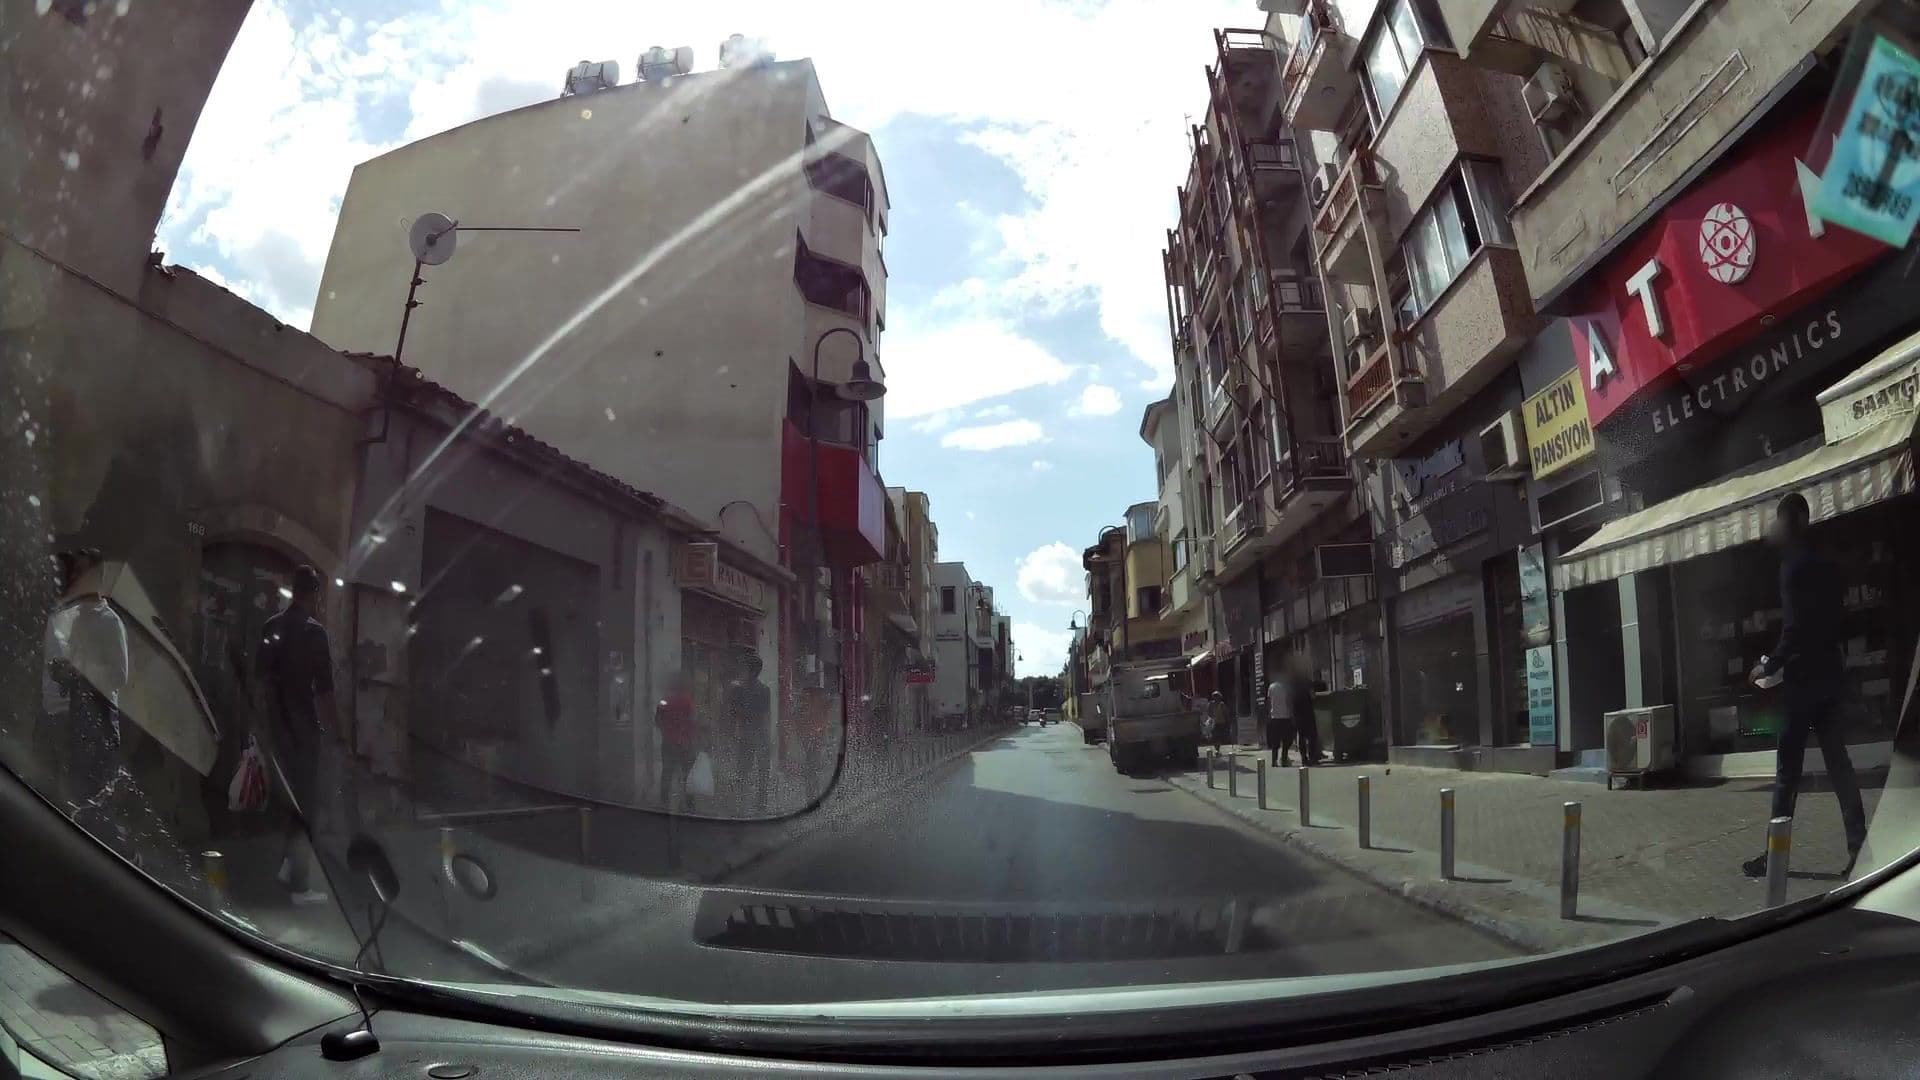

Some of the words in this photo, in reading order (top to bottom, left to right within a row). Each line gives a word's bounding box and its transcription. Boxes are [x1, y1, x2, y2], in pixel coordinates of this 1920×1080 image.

[1653, 309, 1844, 434] ELECTRONICS
[1534, 380, 1577, 429] ALTIN
[1533, 423, 1591, 475] PANSİYON
[188, 522, 206, 537] 168
